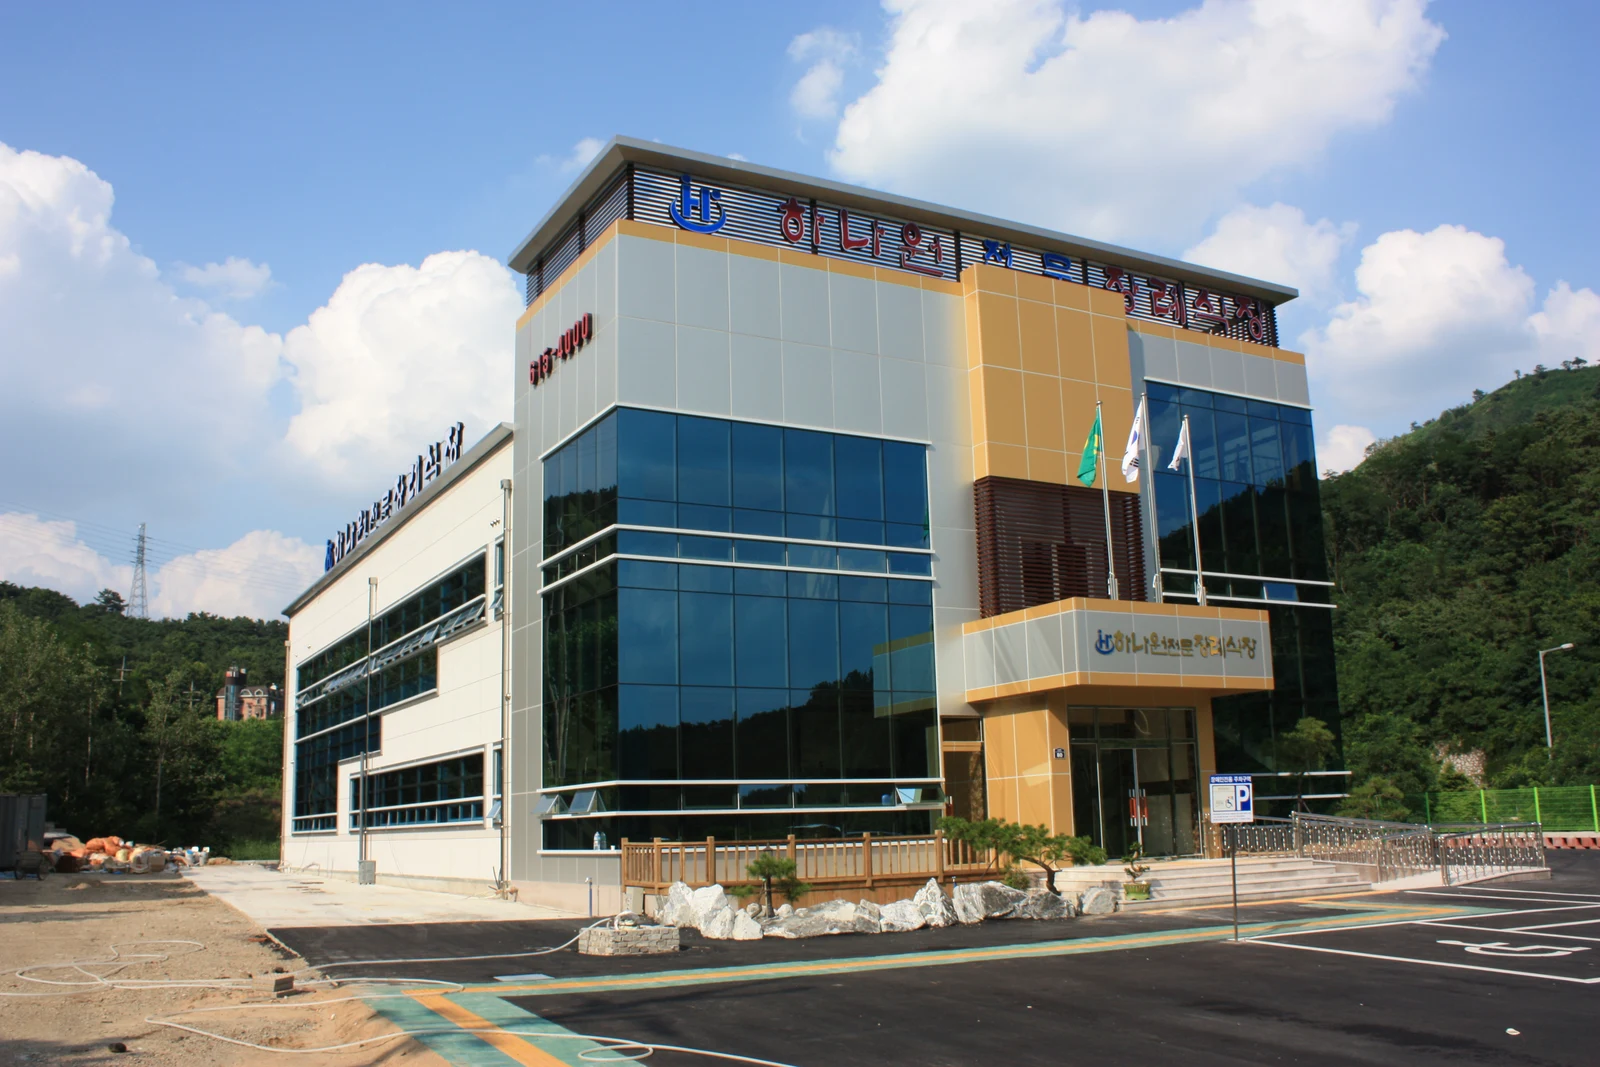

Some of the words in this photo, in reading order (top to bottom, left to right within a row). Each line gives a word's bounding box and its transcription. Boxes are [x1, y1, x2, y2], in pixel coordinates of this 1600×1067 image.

[778, 197, 944, 277] 하나원
[1105, 265, 1264, 340] 장례식장
[529, 312, 592, 386] 615-4000
[1236, 785, 1249, 810] P
